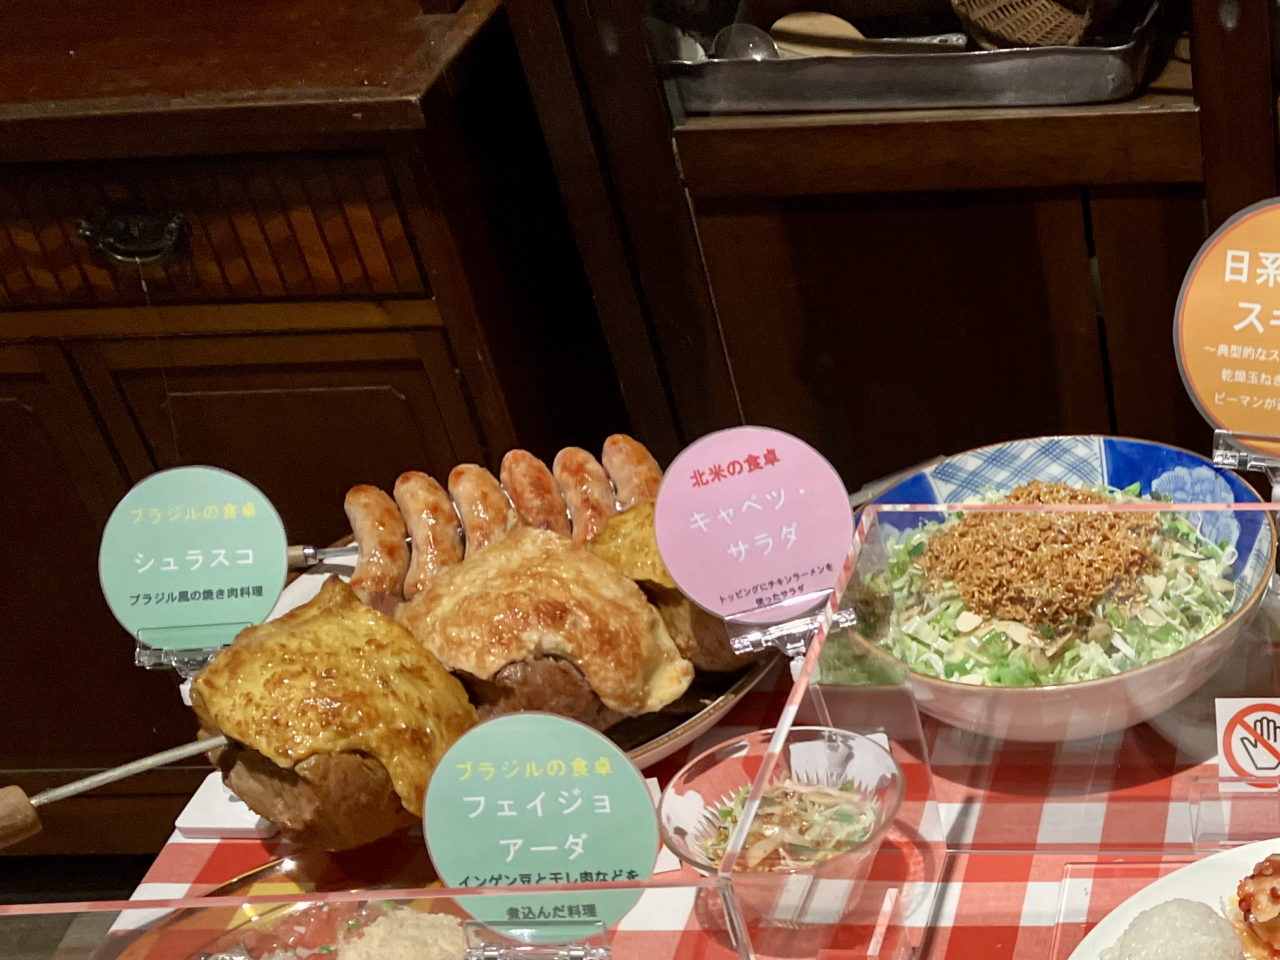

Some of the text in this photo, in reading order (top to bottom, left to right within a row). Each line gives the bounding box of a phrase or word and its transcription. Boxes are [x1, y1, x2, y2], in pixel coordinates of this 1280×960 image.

[689, 447, 781, 489] 北米の食卓
[129, 501, 258, 524] ブラジルの食卓
[727, 522, 798, 563] サラダ
[134, 548, 254, 574] シュラスコ
[129, 585, 264, 606] ブラジル風の焼き肉料理
[456, 756, 614, 781] ブラジルの食卓
[463, 788, 612, 818] フェイジョ
[499, 832, 588, 862] アーダ
[506, 903, 598, 921] 煮込んだ料理
